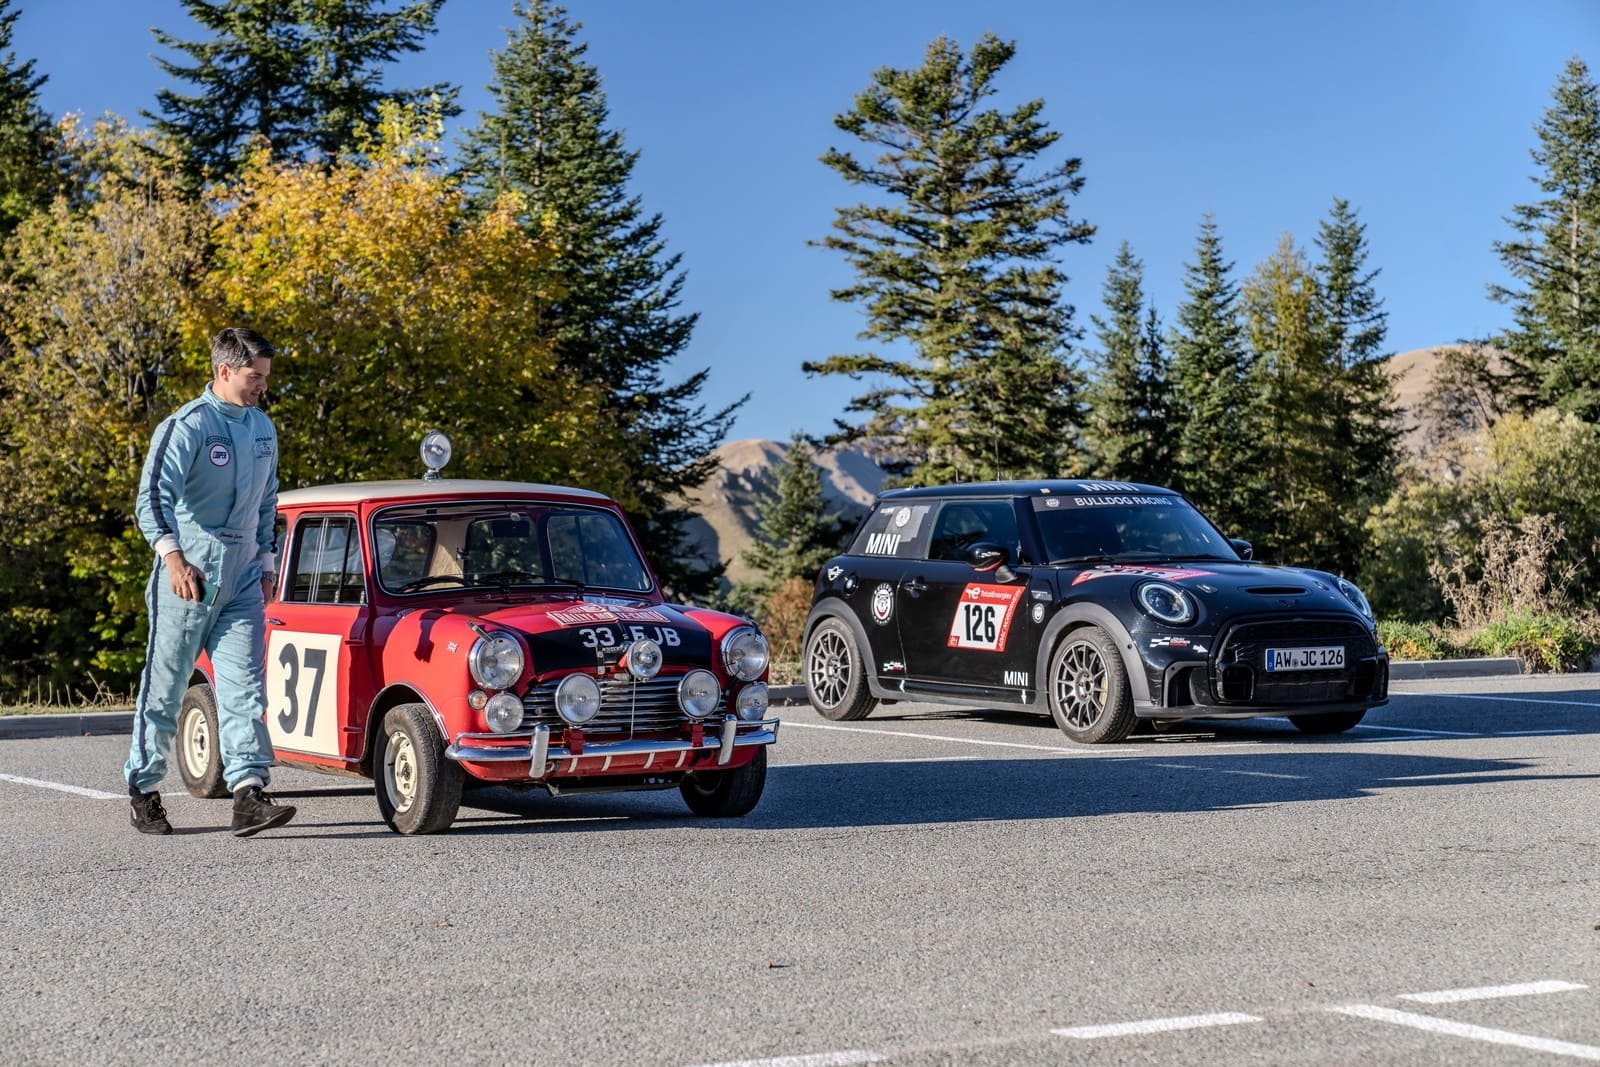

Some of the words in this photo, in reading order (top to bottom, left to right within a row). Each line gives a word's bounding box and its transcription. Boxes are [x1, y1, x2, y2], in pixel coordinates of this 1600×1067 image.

[1078, 482, 1140, 492] MINI
[1074, 497, 1133, 506] BULLDOG
[1133, 497, 1173, 506] RACING
[865, 533, 901, 556] MINI
[964, 604, 996, 643] 126
[579, 627, 615, 648] 33
[1275, 651, 1292, 668] AW
[1300, 651, 1317, 666] JC
[1320, 650, 1343, 666] 126
[1004, 671, 1028, 687] MINI
[278, 643, 327, 737] 37
